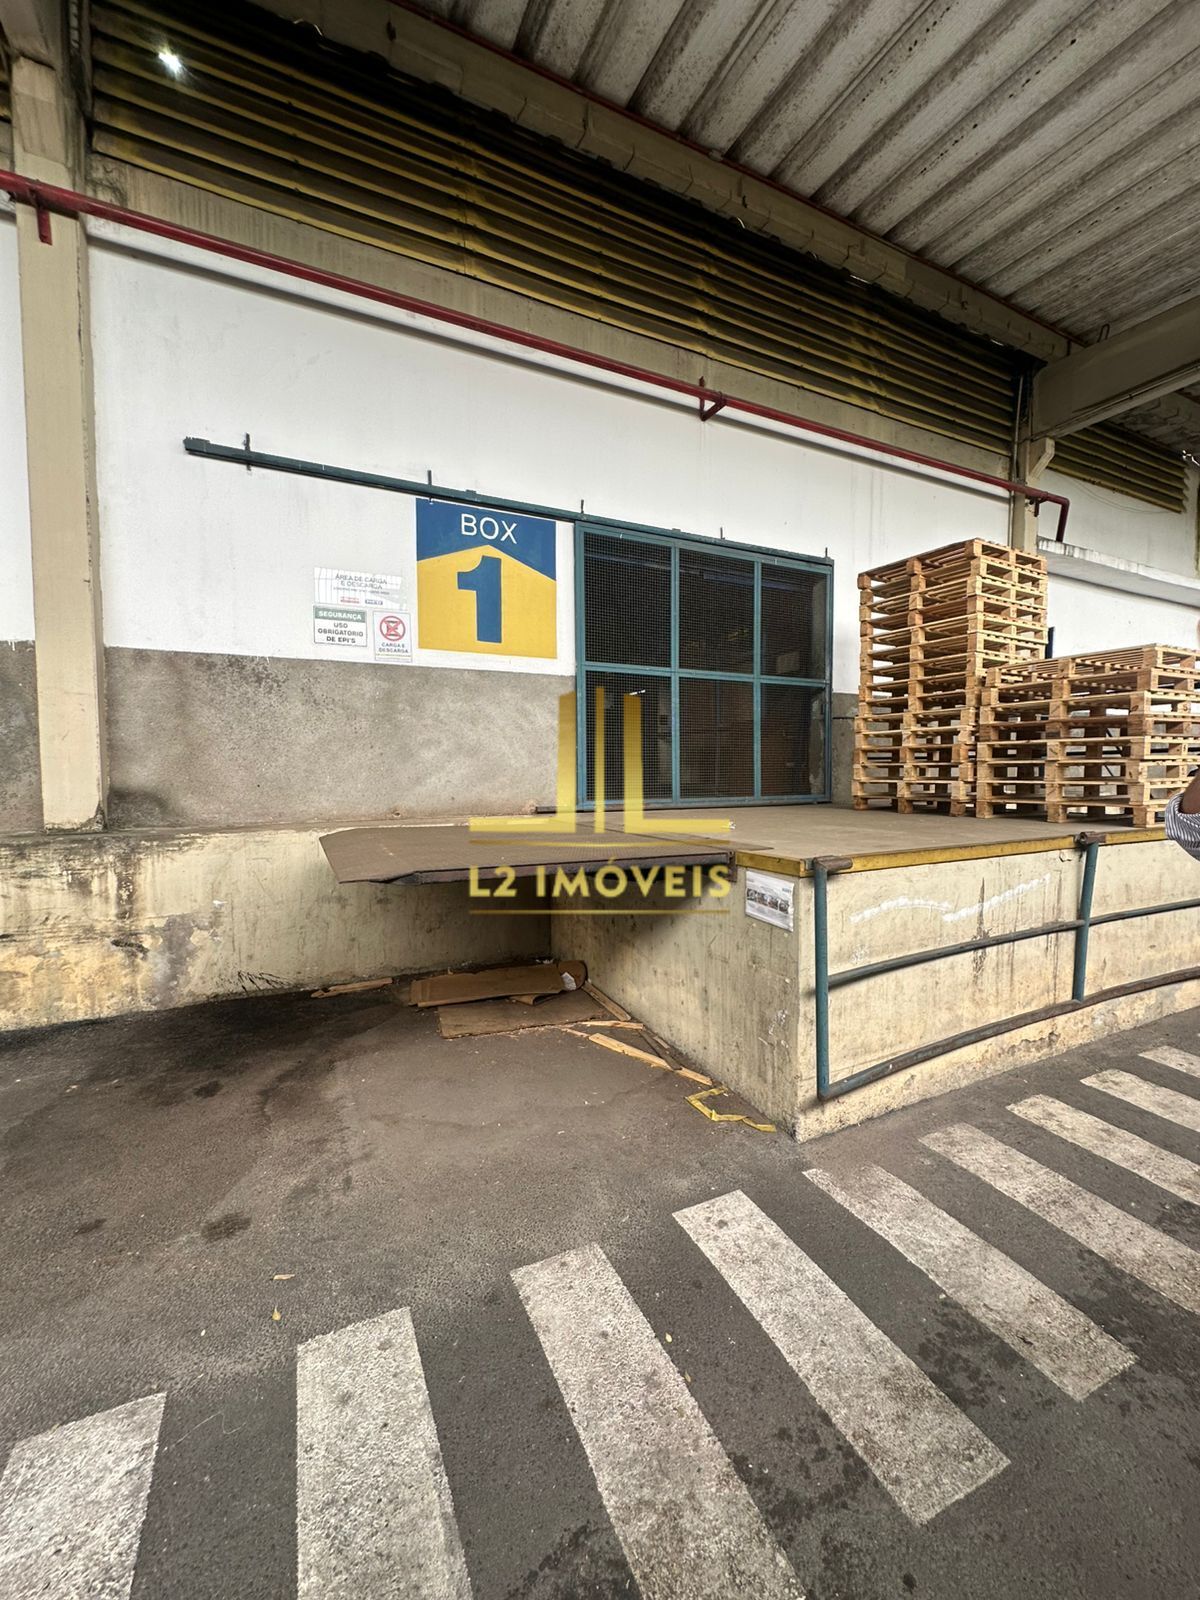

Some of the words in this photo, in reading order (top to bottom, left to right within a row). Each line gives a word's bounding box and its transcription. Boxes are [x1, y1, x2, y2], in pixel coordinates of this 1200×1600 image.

[461, 513, 517, 544] BOX
[335, 573, 353, 581] ÁREA
[364, 576, 388, 584] CARGA
[346, 581, 383, 589] DESCARGA
[457, 555, 502, 643] 1
[318, 610, 362, 621] SEGURANÇA
